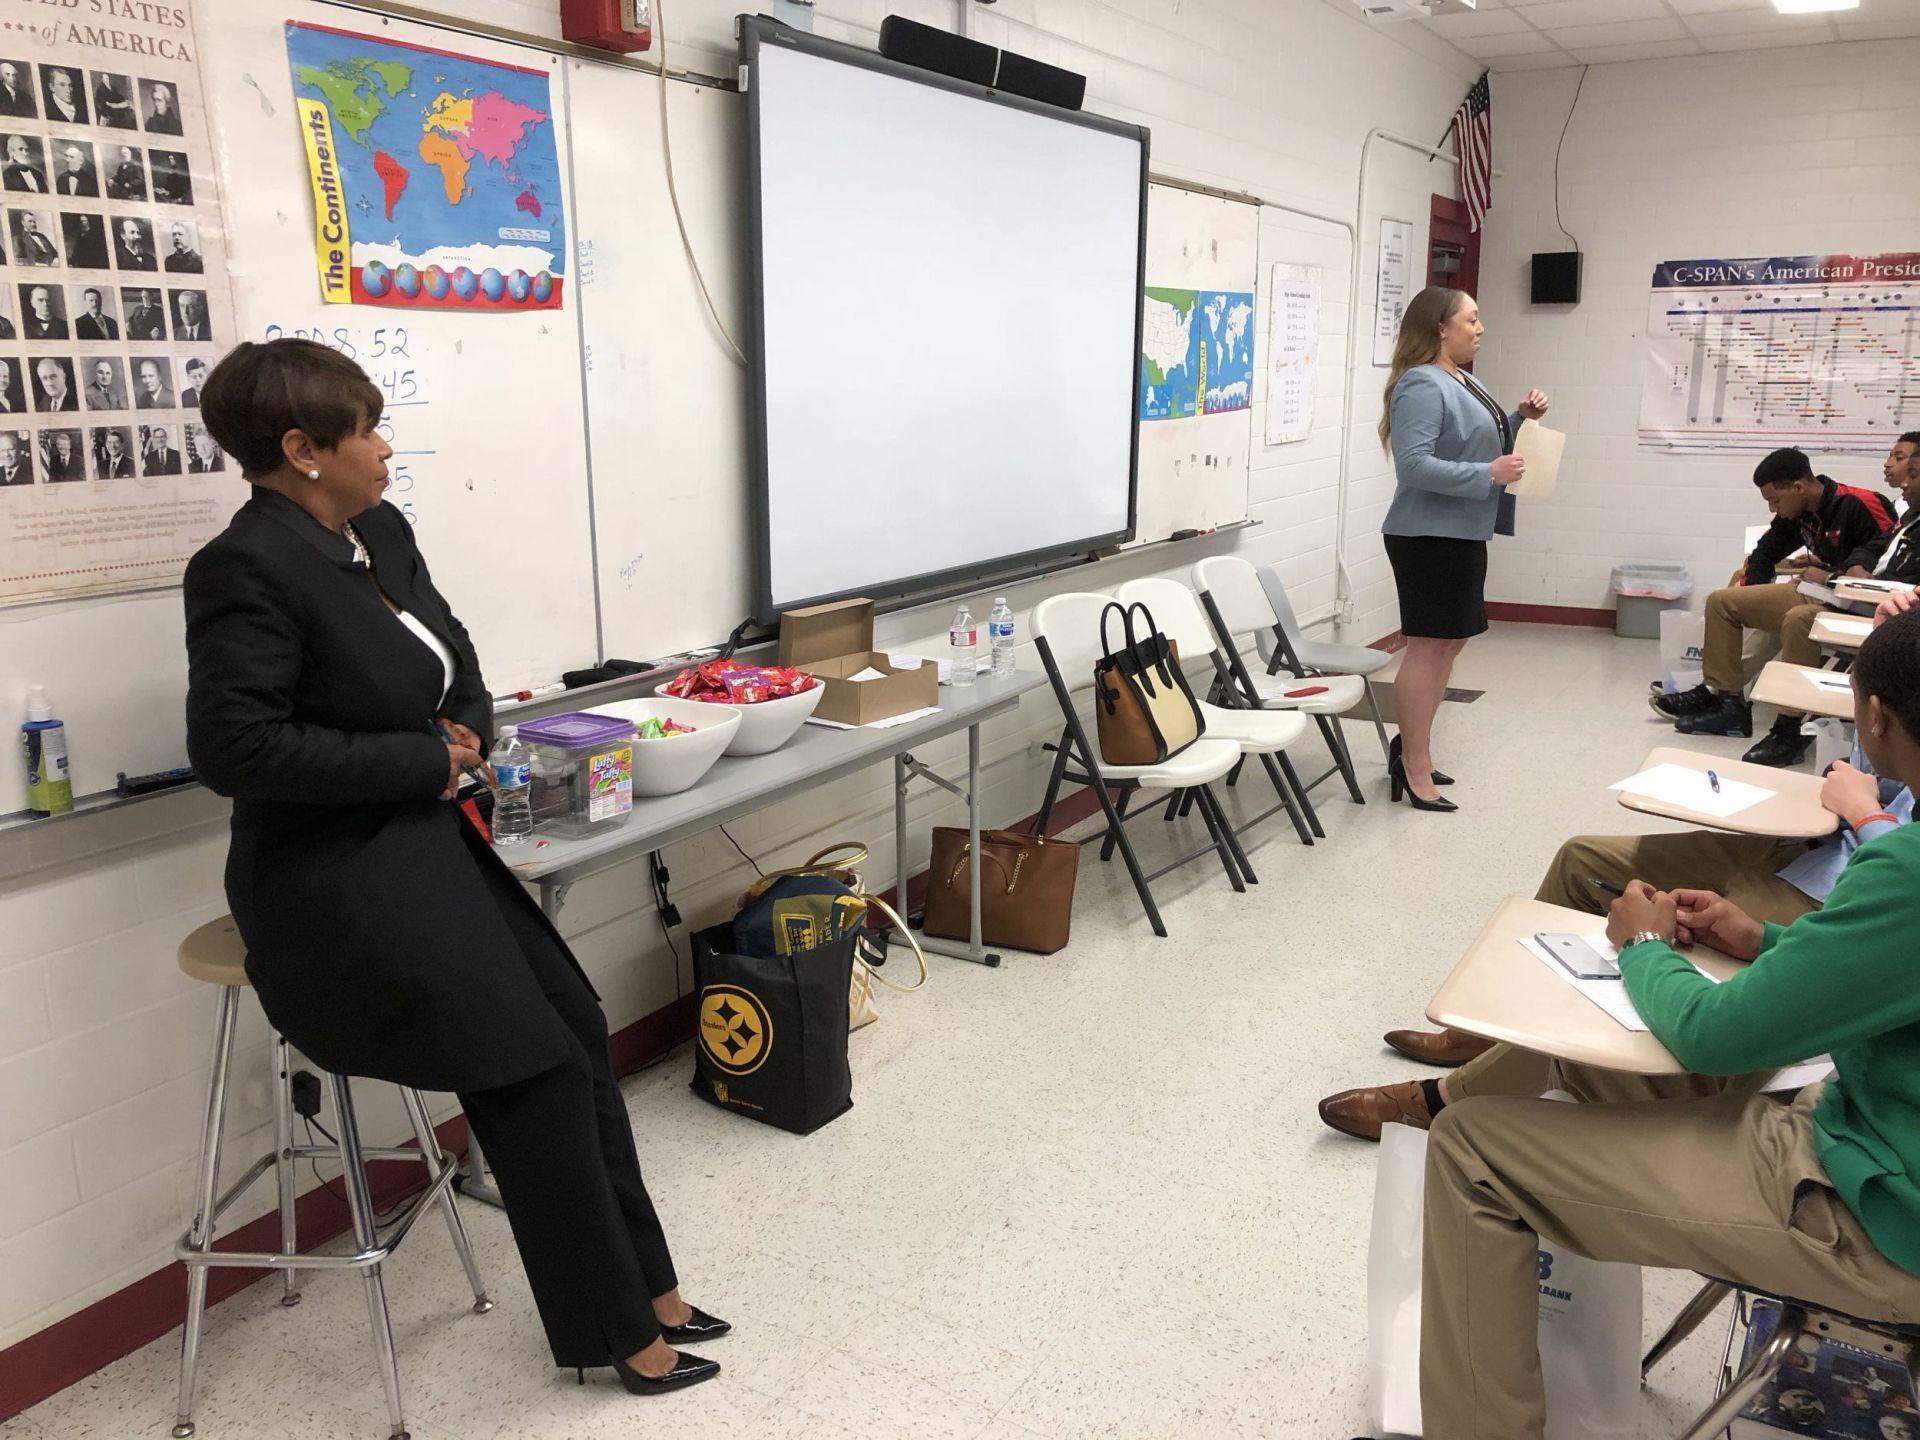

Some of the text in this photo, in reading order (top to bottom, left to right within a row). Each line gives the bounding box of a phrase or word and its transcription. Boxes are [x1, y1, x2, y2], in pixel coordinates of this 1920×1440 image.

[91, 0, 186, 28] STATES
[42, 21, 192, 62] of AMERICA
[309, 109, 344, 292] The Continents
[1673, 265, 1755, 283] C-SPAN's
[1761, 264, 1854, 280] American
[1686, 646, 1704, 657] FN
[593, 753, 616, 772] Laffy
[599, 768, 620, 781] Taffy
[703, 1018, 726, 1032] Steelers
